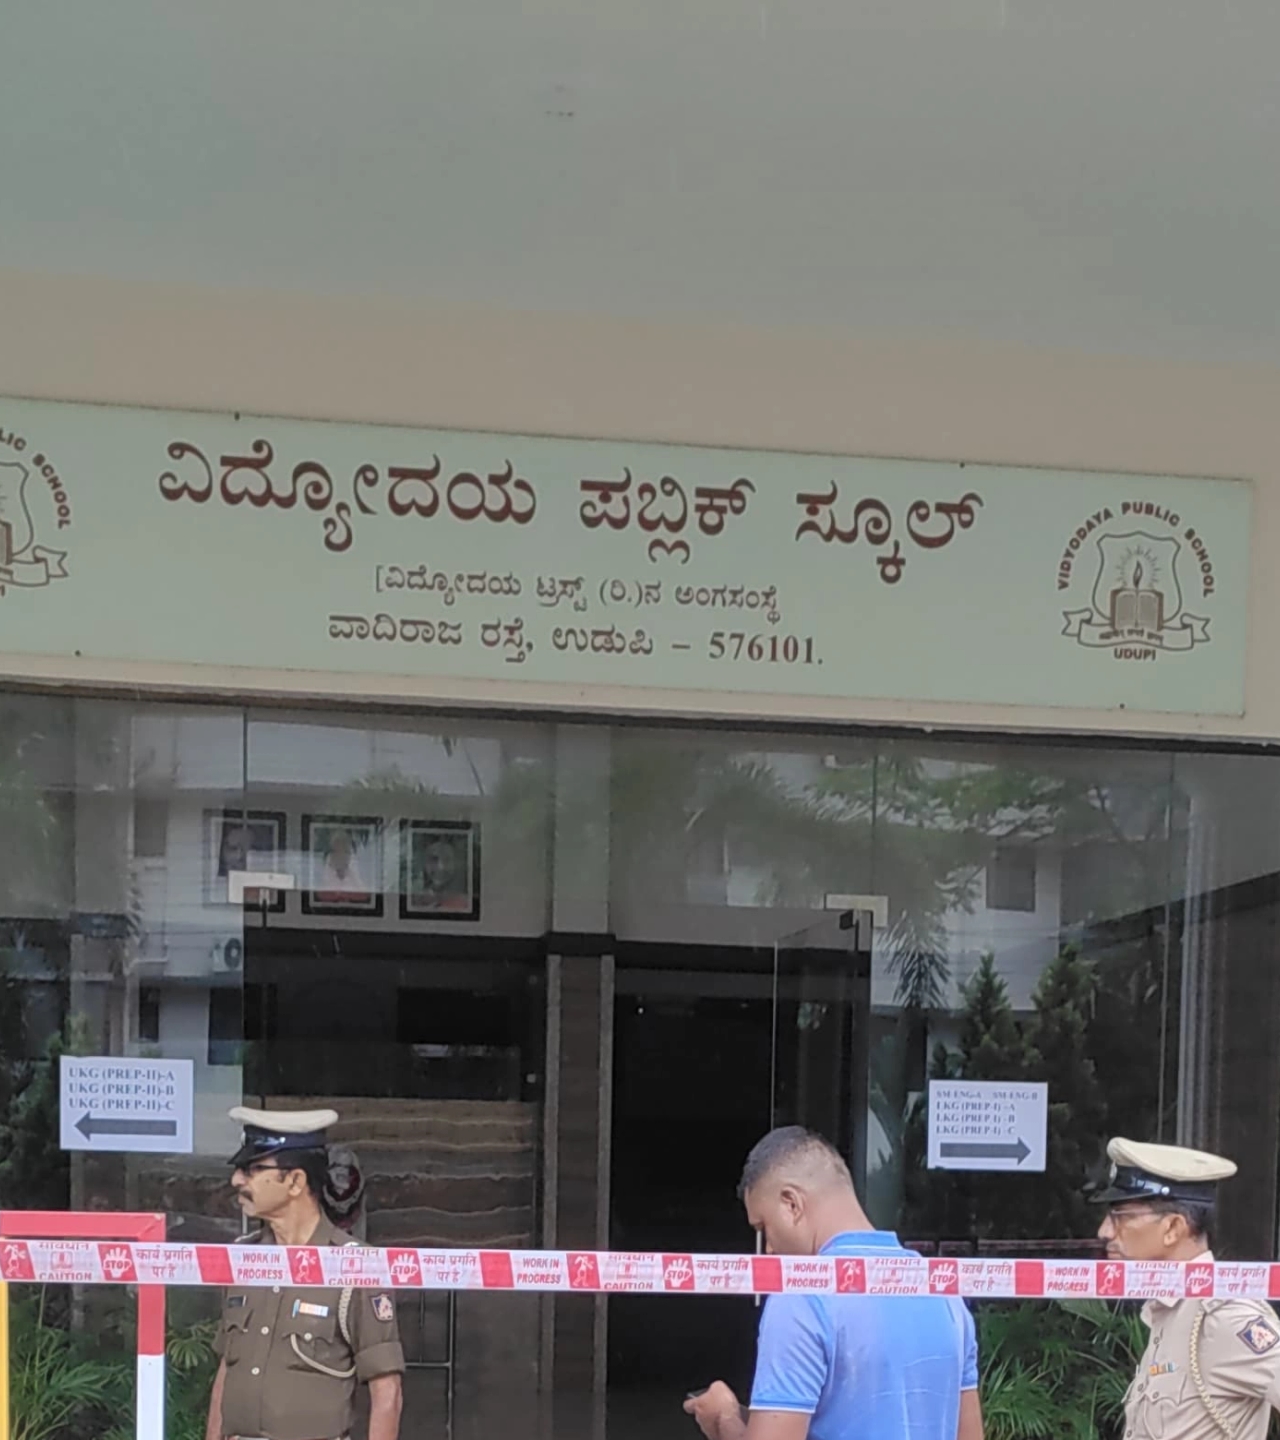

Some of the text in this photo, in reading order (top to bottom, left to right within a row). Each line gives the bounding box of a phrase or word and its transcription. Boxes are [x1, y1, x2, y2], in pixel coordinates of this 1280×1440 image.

[32, 453, 71, 529] SCHOOL
[158, 439, 984, 584] ವಿದ್ಯೋದಯ ಪಬ್ಲಿಕ್ ಸ್ಕೂಲ್
[1058, 502, 1214, 598] VIDYODAYA PUBLIC SCHOOL
[536, 575, 587, 612] ಟ್ರಸ್ಟ್
[675, 584, 780, 625] ಅಂಗಸಂಸ್ಥೆ
[328, 611, 463, 647] ವಾದಿರಾಜ
[481, 617, 533, 663] ರಸ್ತೆ,
[552, 623, 654, 655] ಉಡುಪಿ
[709, 631, 823, 665] 576101.
[1114, 648, 1156, 661] UDUPI
[69, 1068, 99, 1079] UKG
[69, 1083, 99, 1093] UKG
[69, 1098, 99, 1109] UKG
[242, 1252, 280, 1263] WORK IN
[522, 1257, 559, 1268] WORK IN
[104, 1260, 130, 1270] STOP
[794, 1263, 828, 1273] WORK IN
[237, 1269, 283, 1280] PROGRESS
[393, 1266, 417, 1275] STOP
[667, 1269, 690, 1279] STOP
[1055, 1267, 1078, 1276] WORK
[39, 1272, 92, 1281] CAUTION
[517, 1273, 561, 1285] PROGRESS
[931, 1274, 955, 1284] STOP
[328, 1278, 380, 1286] CAUTION
[604, 1282, 653, 1290] CAUTION
[786, 1278, 828, 1288] PROGRESS
[1047, 1282, 1088, 1292] PROGRESS
[870, 1286, 917, 1294] CAUTION
